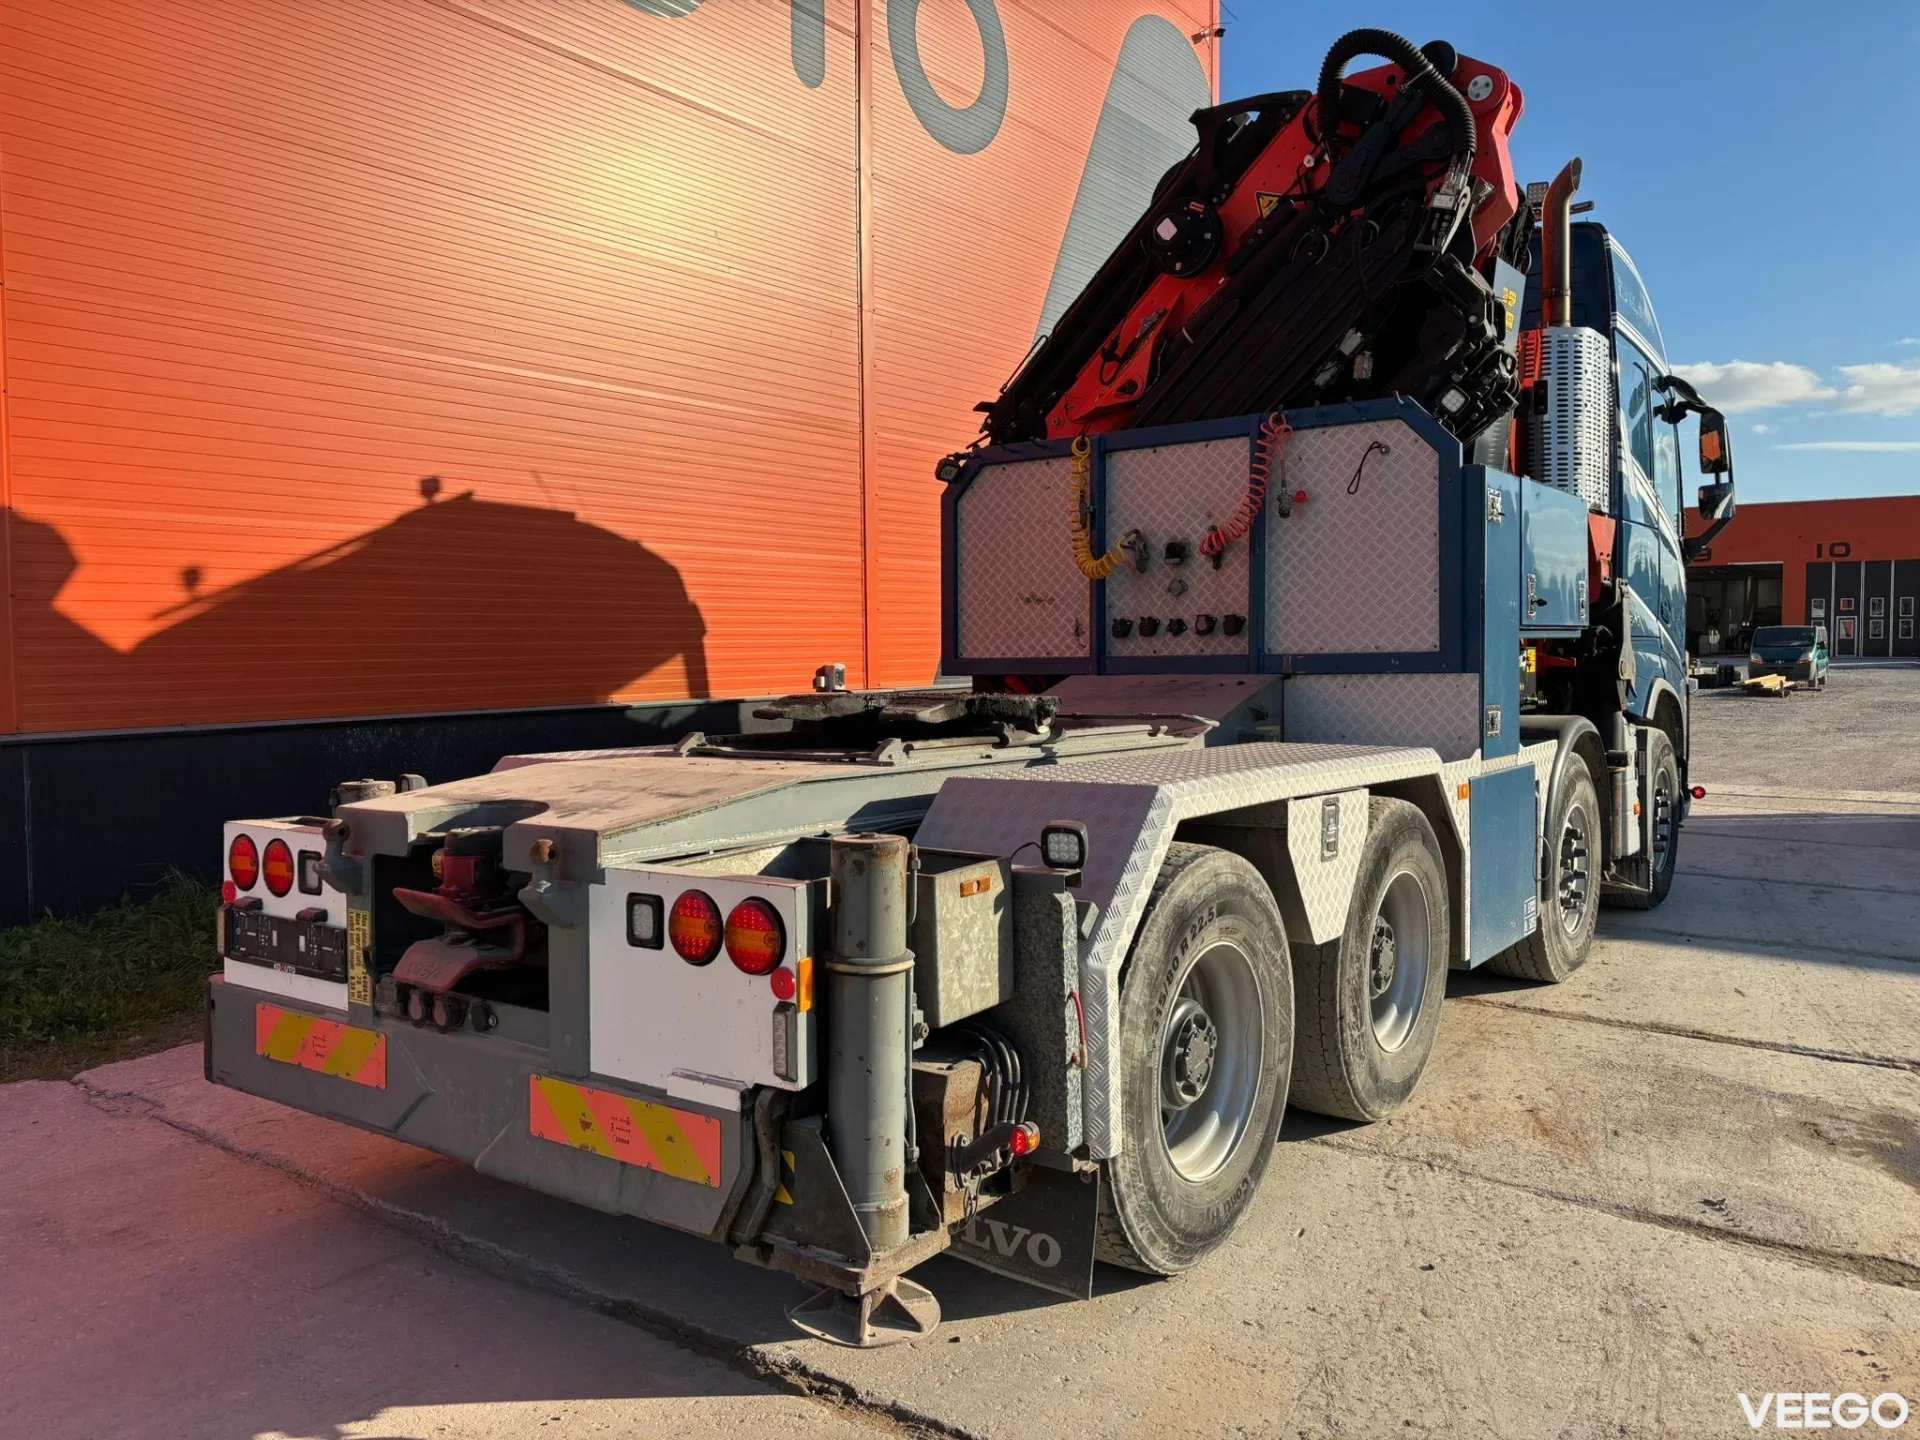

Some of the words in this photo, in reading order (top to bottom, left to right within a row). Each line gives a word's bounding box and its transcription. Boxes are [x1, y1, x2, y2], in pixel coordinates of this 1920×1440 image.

[1816, 542, 1851, 559] 10
[1152, 956, 1180, 1035] 315/80
[1180, 937, 1188, 957] R
[1191, 906, 1215, 939] 22.5
[961, 1216, 1062, 1268] LVO
